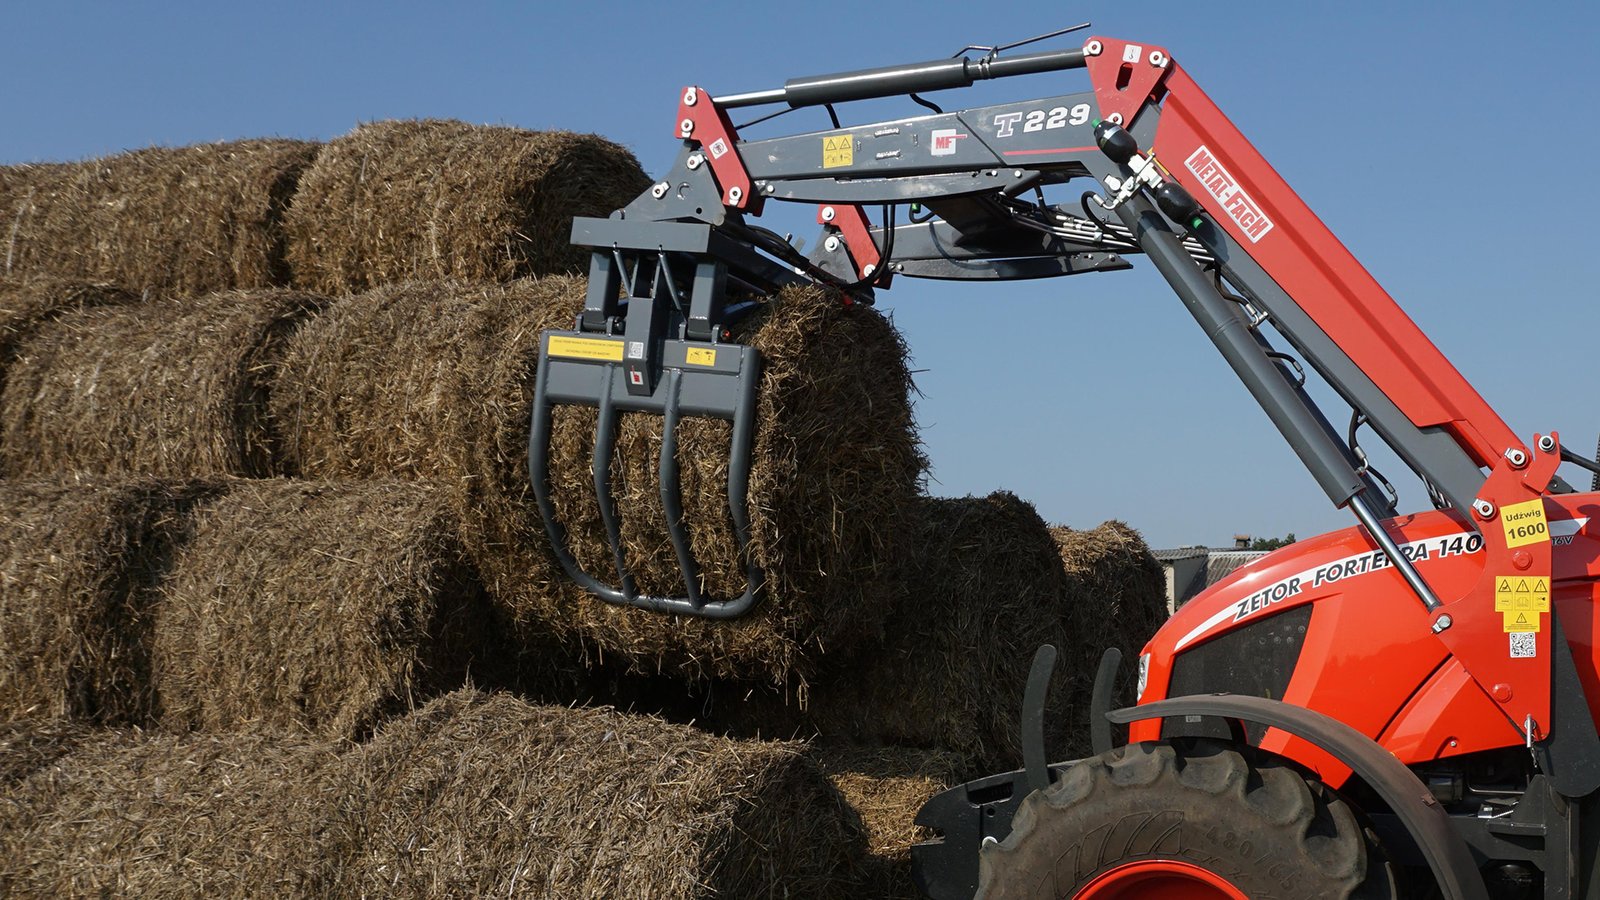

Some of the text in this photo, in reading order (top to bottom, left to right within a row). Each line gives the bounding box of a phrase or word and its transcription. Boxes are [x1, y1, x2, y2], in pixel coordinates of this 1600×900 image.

[994, 103, 1091, 139] T229
[1189, 150, 1269, 238] METAL-FACH
[1506, 509, 1541, 522] Udźwig
[1508, 522, 1545, 539] 1600
[1236, 577, 1302, 620] ZETOR
[1438, 534, 1482, 557] 140
